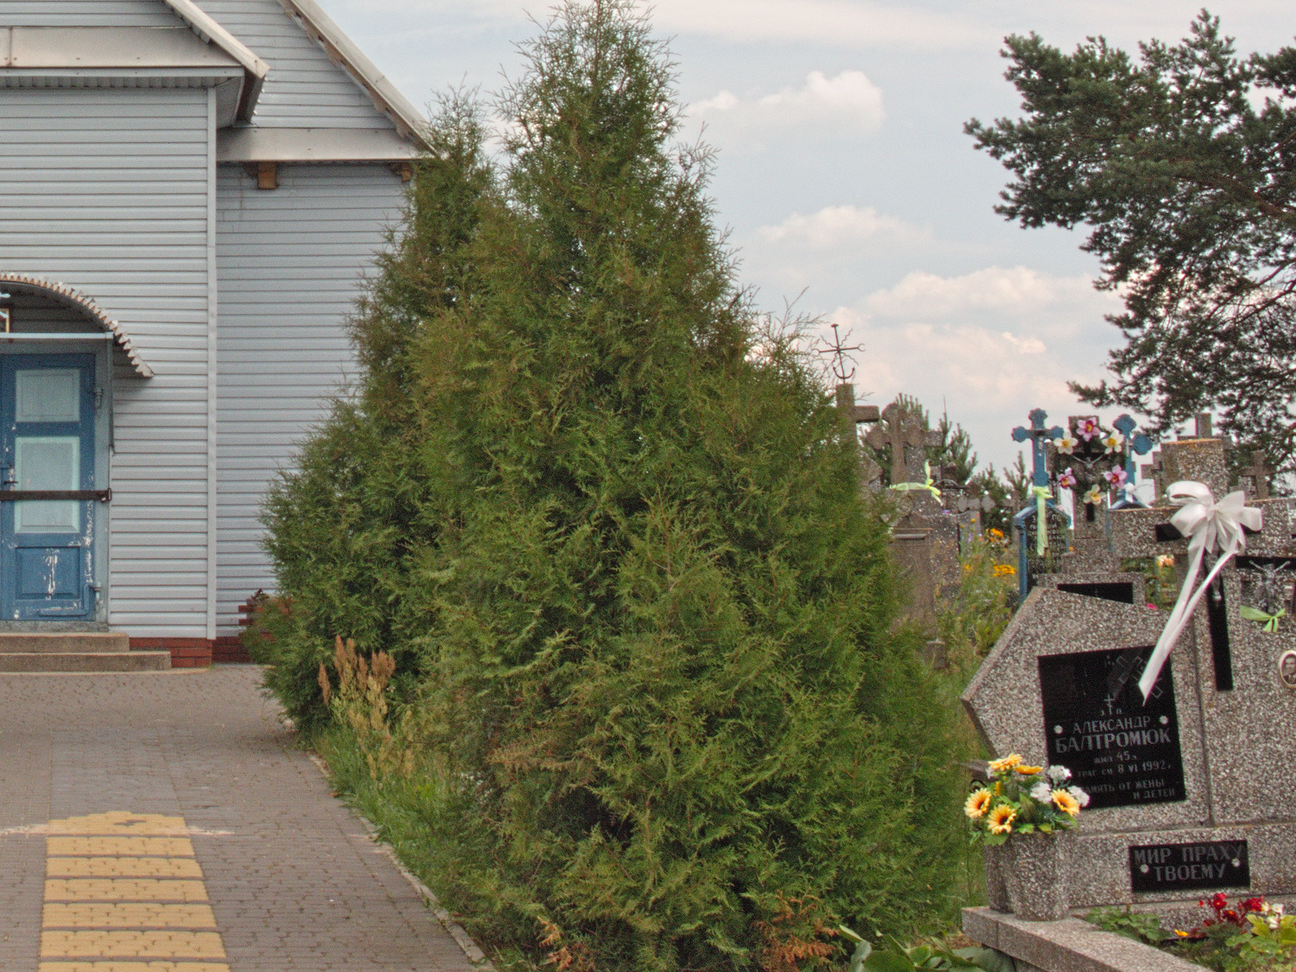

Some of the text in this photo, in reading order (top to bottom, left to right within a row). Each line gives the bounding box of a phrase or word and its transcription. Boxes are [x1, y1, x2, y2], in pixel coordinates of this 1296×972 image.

[1073, 715, 1151, 734] АЛЕКСАНДР
[1055, 728, 1172, 754] БАЛТРОМЮК
[1142, 760, 1166, 772] 1992
[1083, 783, 1115, 794] АМЯТЬ
[1134, 844, 1243, 865] МИР ПРАХУ
[1153, 863, 1226, 882] ТВОЕМУ
